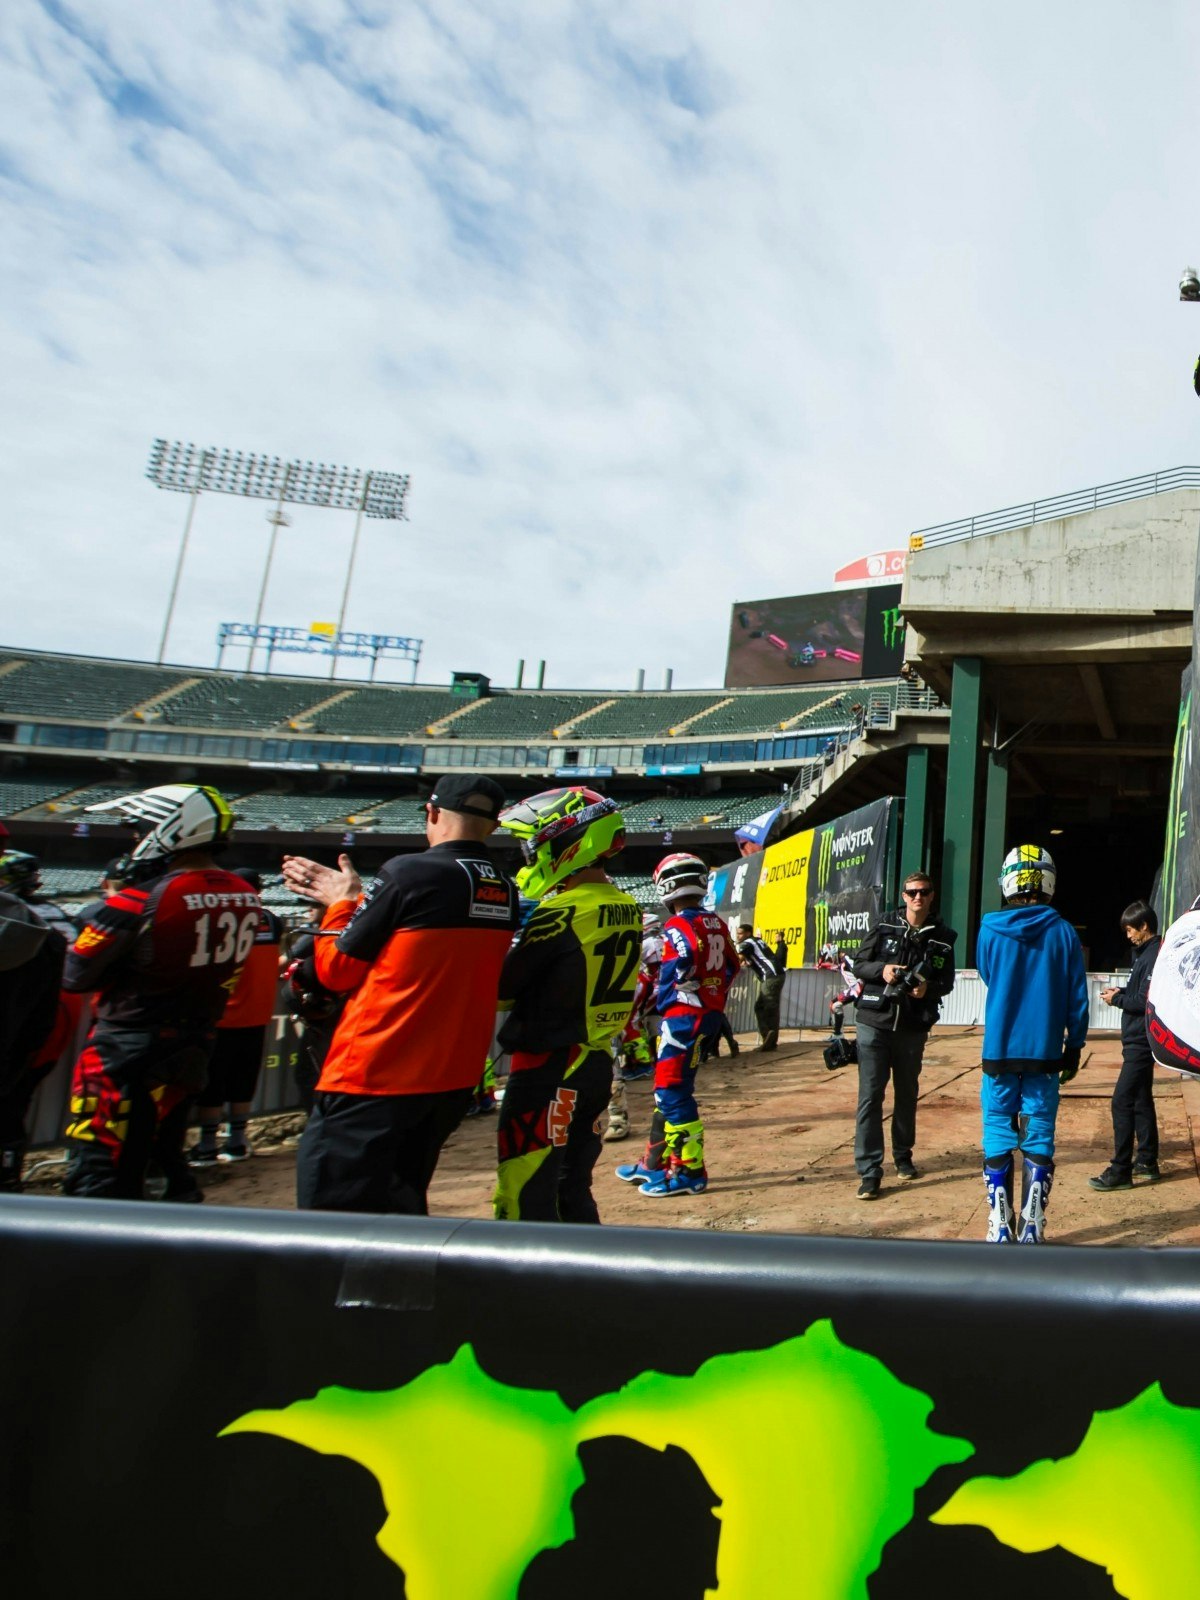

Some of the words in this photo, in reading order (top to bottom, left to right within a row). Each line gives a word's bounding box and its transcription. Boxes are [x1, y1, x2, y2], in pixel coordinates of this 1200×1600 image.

[832, 826, 874, 857] MONSTER
[768, 856, 807, 883] DUNLOP
[835, 855, 865, 870] ENERGY
[828, 910, 870, 936] MONSTER
[189, 911, 260, 967] 136
[547, 1086, 578, 1148] KTM
